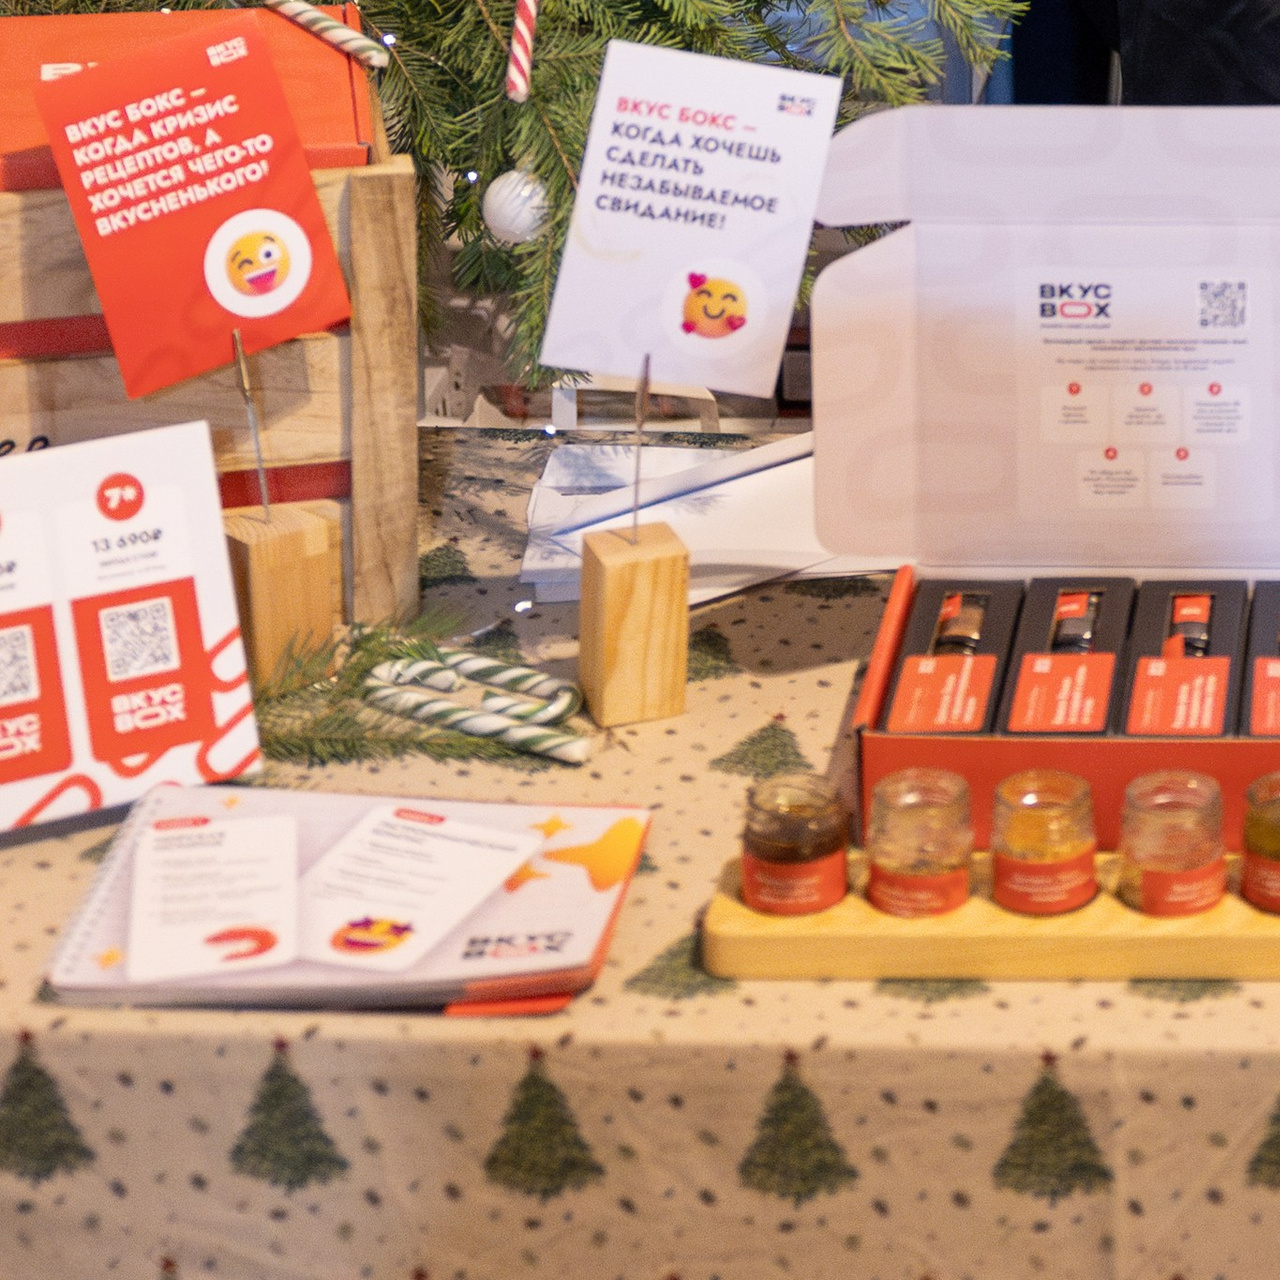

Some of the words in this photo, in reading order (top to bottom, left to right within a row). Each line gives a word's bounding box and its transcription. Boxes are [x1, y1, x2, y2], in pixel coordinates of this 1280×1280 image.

[65, 109, 123, 144] ВКУС
[125, 88, 186, 123] БОКС
[73, 128, 149, 167] КОГДА
[150, 95, 239, 139] КРИЗИС
[617, 97, 672, 119] ВКУС
[679, 107, 736, 131] БОКС
[80, 136, 201, 190] РЕЦЕПТОВ,
[204, 127, 222, 147] А
[607, 146, 704, 175] СДЕЛАТЬ
[611, 121, 682, 147] КОГДА
[691, 135, 781, 163] ХОЧЕШЬ
[88, 164, 185, 213] ХОЧЕТСЯ
[188, 133, 274, 174] ЧЕГО-ТО
[601, 170, 778, 213] НЕЗАБЫВАЕМОЕ
[95, 160, 269, 237] ВКУСНЕНЬКОГО!
[595, 194, 726, 229] СВИДАНИЕ!
[1040, 284, 1111, 299] ВКУС
[1040, 302, 1110, 318] BOX
